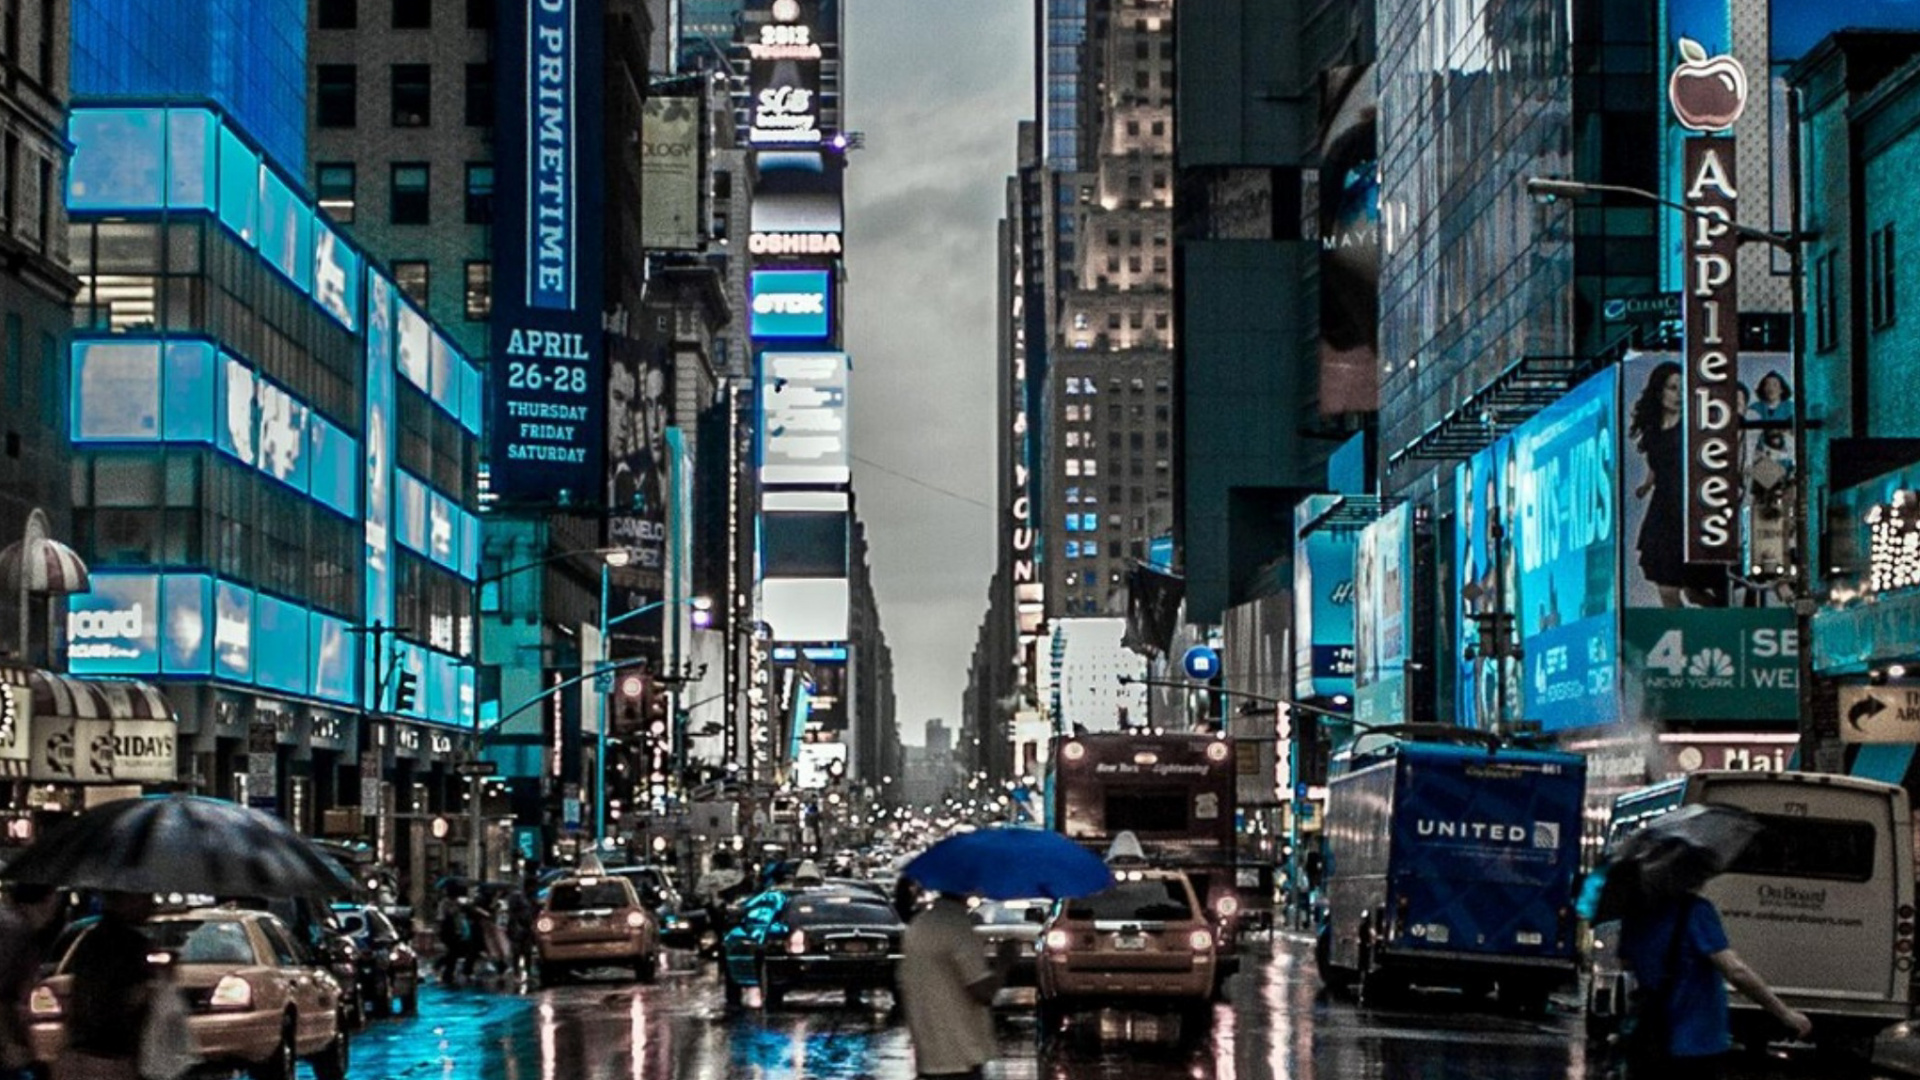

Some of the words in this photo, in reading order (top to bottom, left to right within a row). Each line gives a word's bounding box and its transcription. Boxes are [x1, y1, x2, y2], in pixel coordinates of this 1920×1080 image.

[539, 25, 563, 292] PRIMETIME
[507, 328, 590, 361] APRIL
[1687, 149, 1737, 547] Applebee's
[508, 361, 587, 394] 26-28
[507, 400, 588, 421] THURSDAY
[520, 422, 575, 441] FRIDAY
[507, 443, 587, 463] SATURDAY
[1646, 629, 1688, 676] 4
[1417, 819, 1526, 841] UNITED
